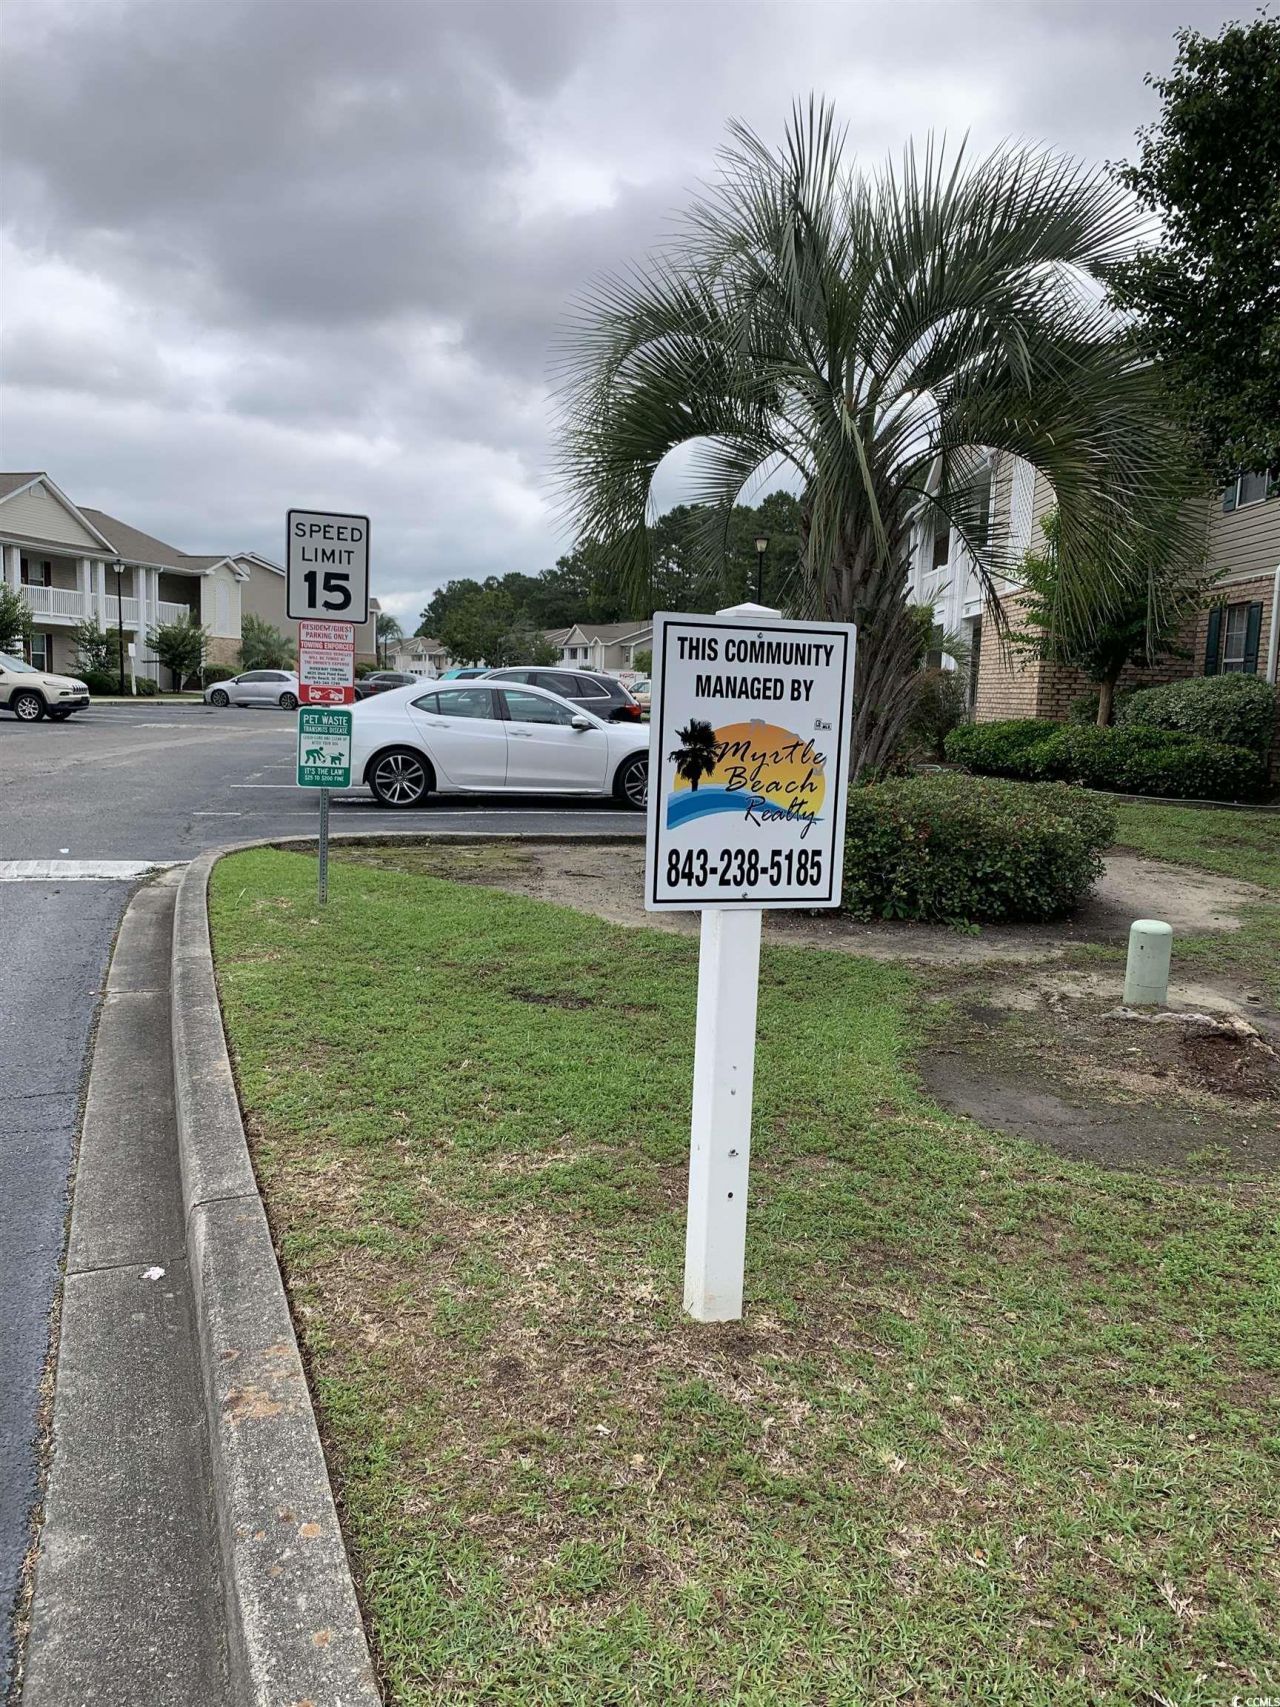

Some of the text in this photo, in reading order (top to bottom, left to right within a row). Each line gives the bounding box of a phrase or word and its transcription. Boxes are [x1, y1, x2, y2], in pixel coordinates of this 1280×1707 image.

[295, 523, 363, 542] SPEED
[302, 547, 354, 565] LIMIT
[304, 570, 352, 611] 15
[302, 624, 352, 633] RESIDENT/GUEST
[306, 631, 332, 639] PARKING
[677, 636, 835, 667] THIS COMMUNITY
[695, 675, 815, 702] MANAGED BY
[304, 714, 348, 725] PET WASTE
[305, 767, 315, 775] IT'S
[713, 738, 827, 781] Myrtle
[725, 766, 818, 793] Beach
[744, 796, 818, 839] Realty
[666, 848, 823, 887] 843-238-5185
